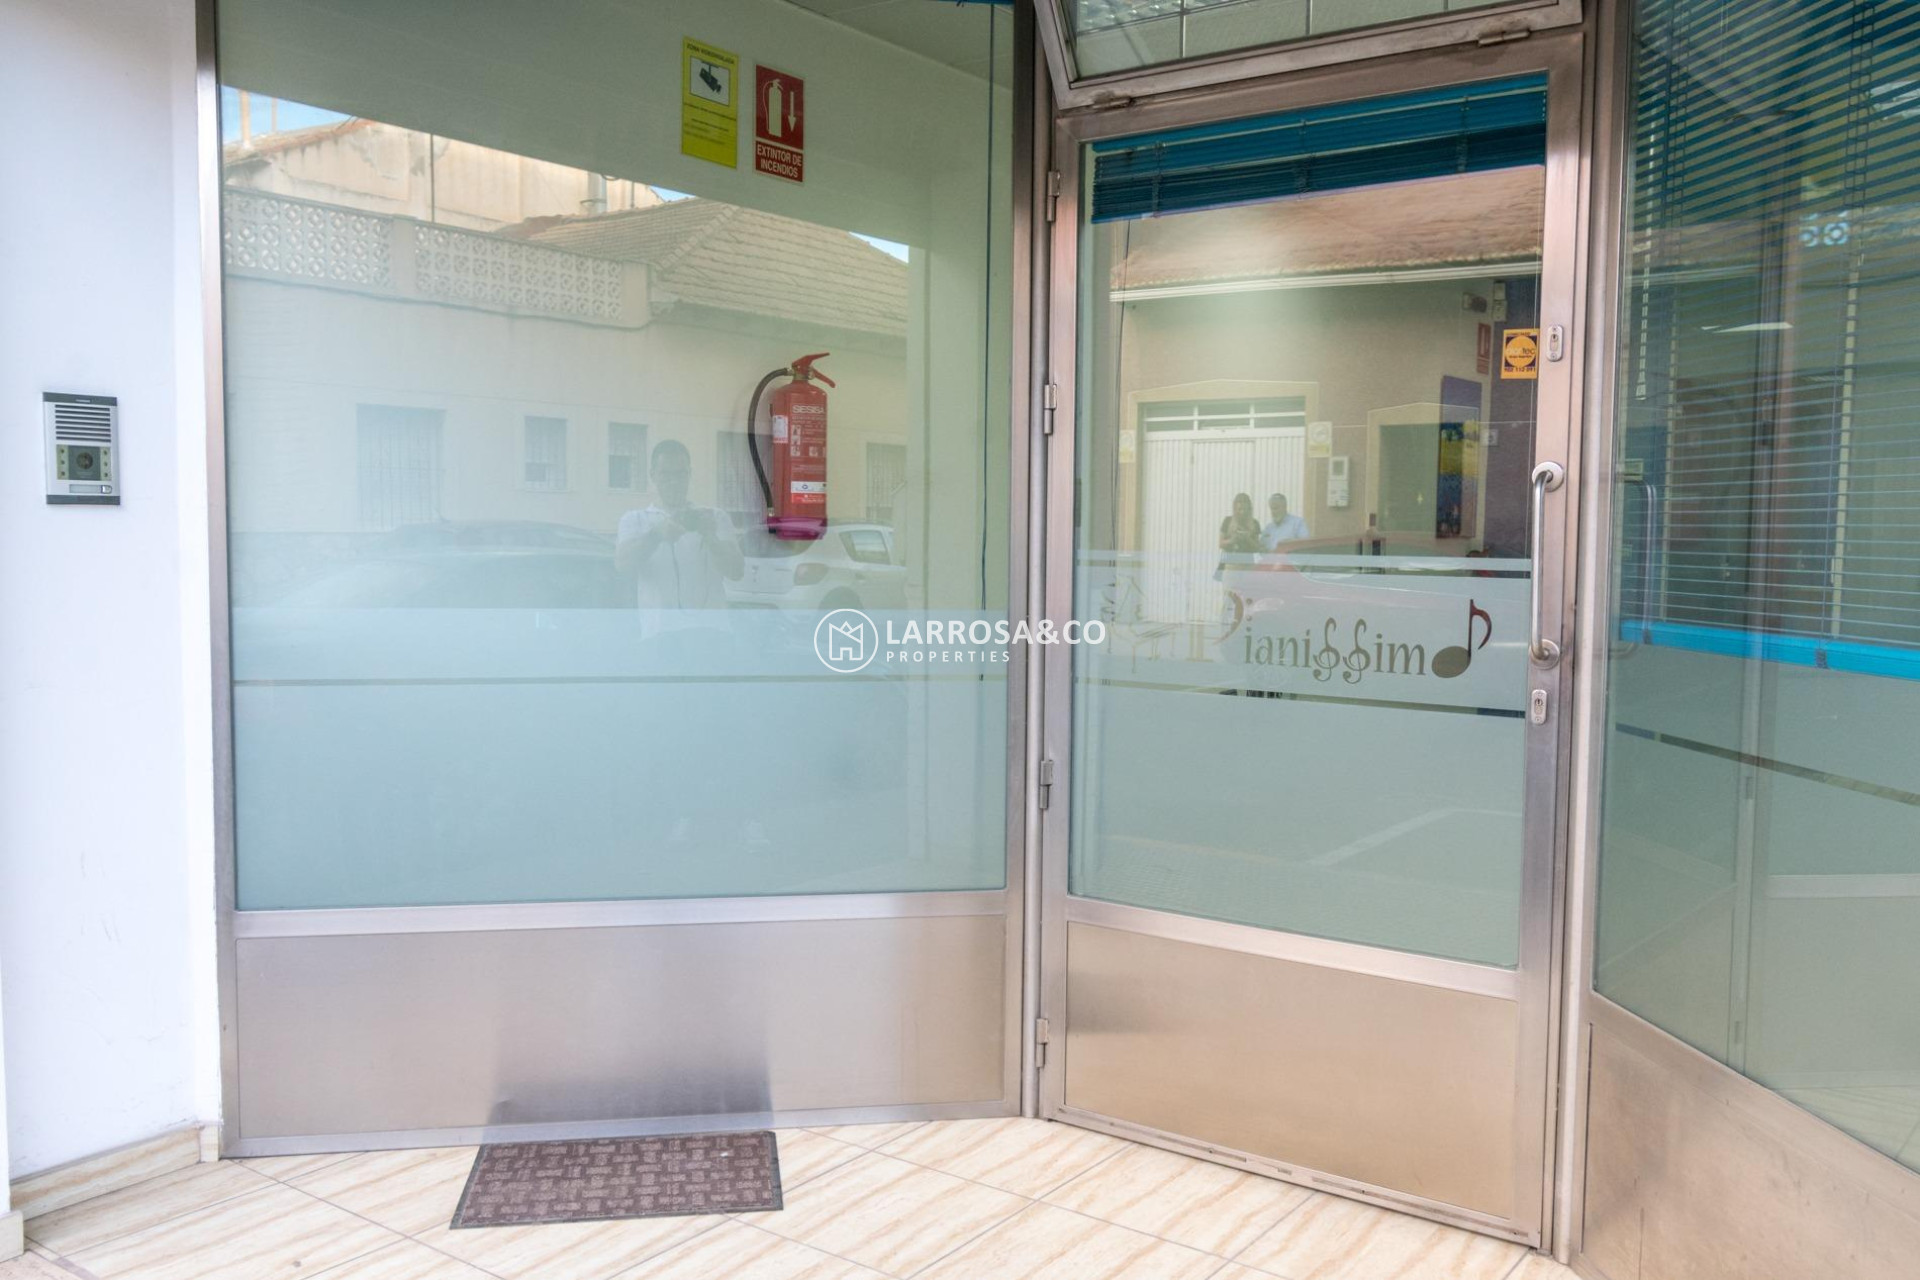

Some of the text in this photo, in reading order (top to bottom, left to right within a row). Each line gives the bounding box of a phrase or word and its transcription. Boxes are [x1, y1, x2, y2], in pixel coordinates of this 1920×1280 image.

[758, 144, 802, 167] EXTINTOR DE
[761, 158, 798, 178] INCENDIOS
